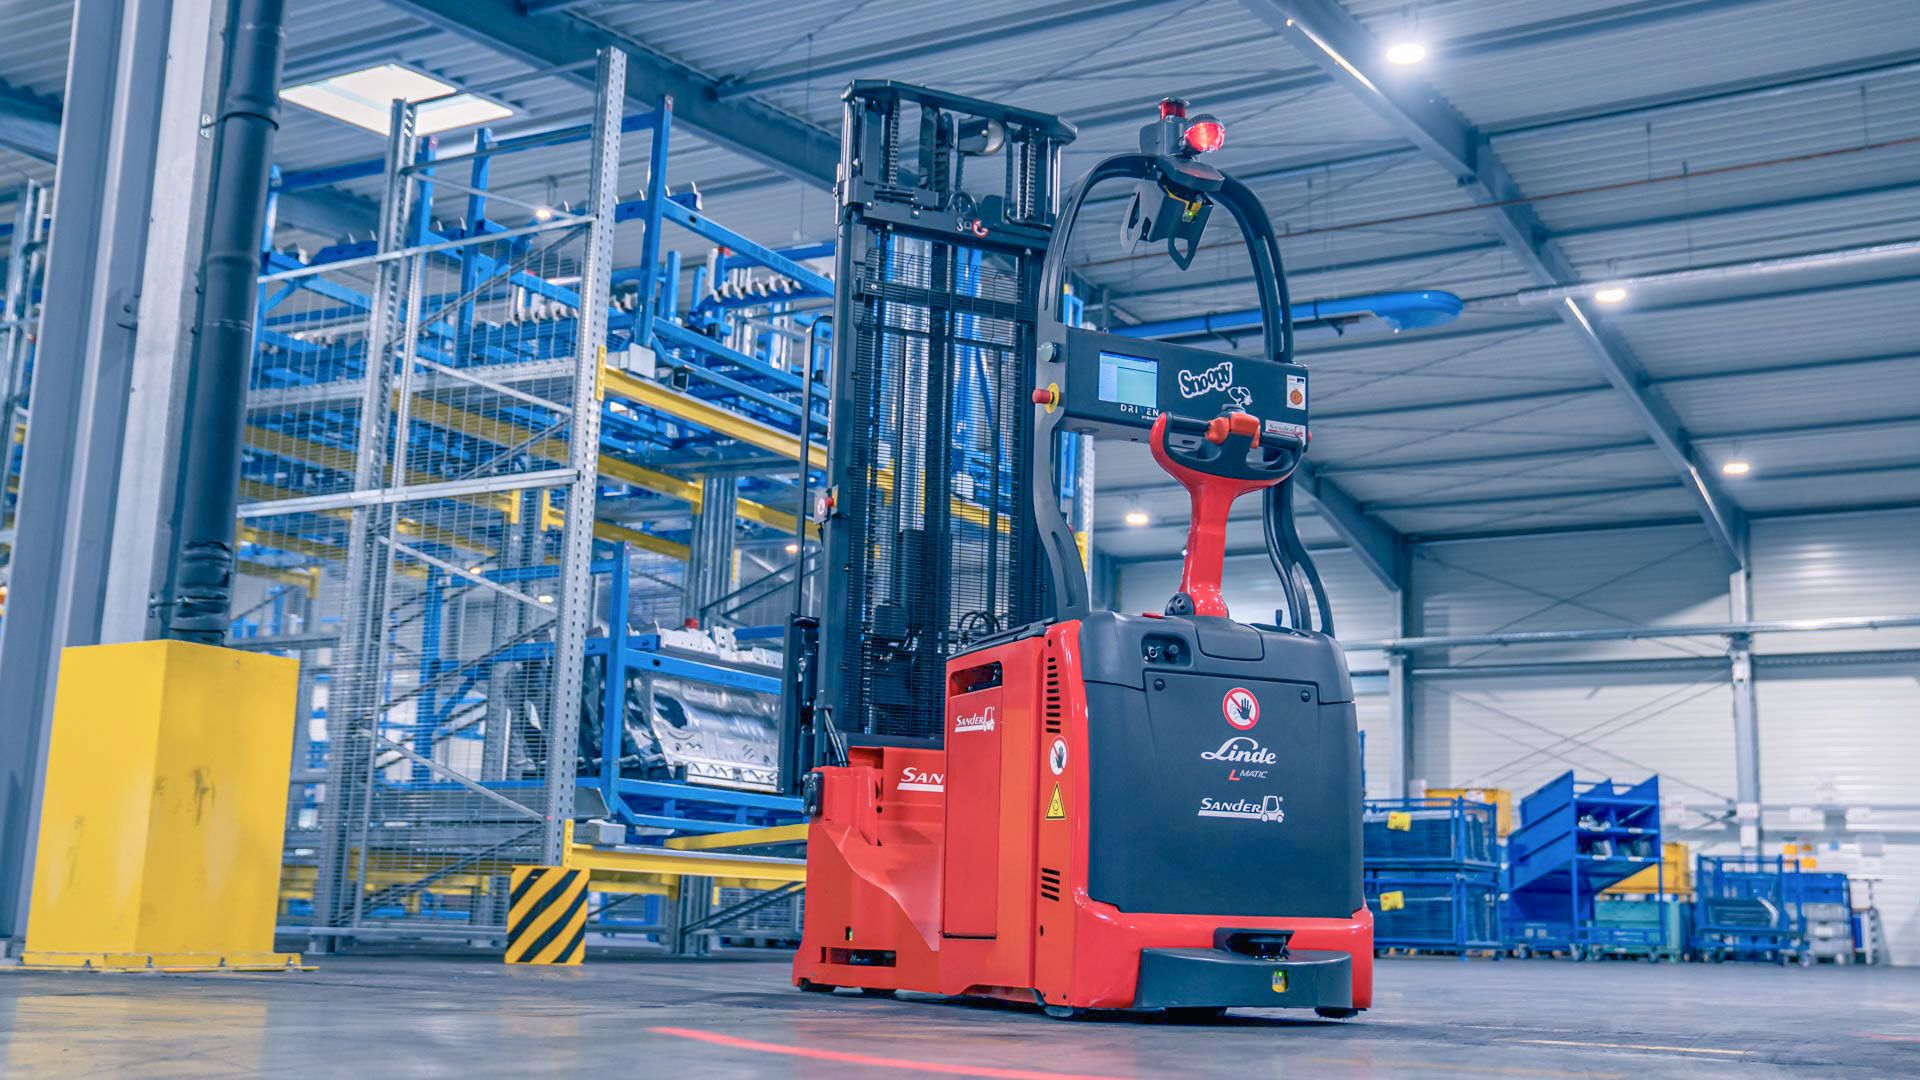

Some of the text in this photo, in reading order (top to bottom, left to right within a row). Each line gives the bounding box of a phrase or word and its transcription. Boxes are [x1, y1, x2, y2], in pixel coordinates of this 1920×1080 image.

[1178, 362, 1233, 399] Snoopy
[1120, 404, 1159, 417] DRIVEN
[1200, 736, 1277, 765] Linde
